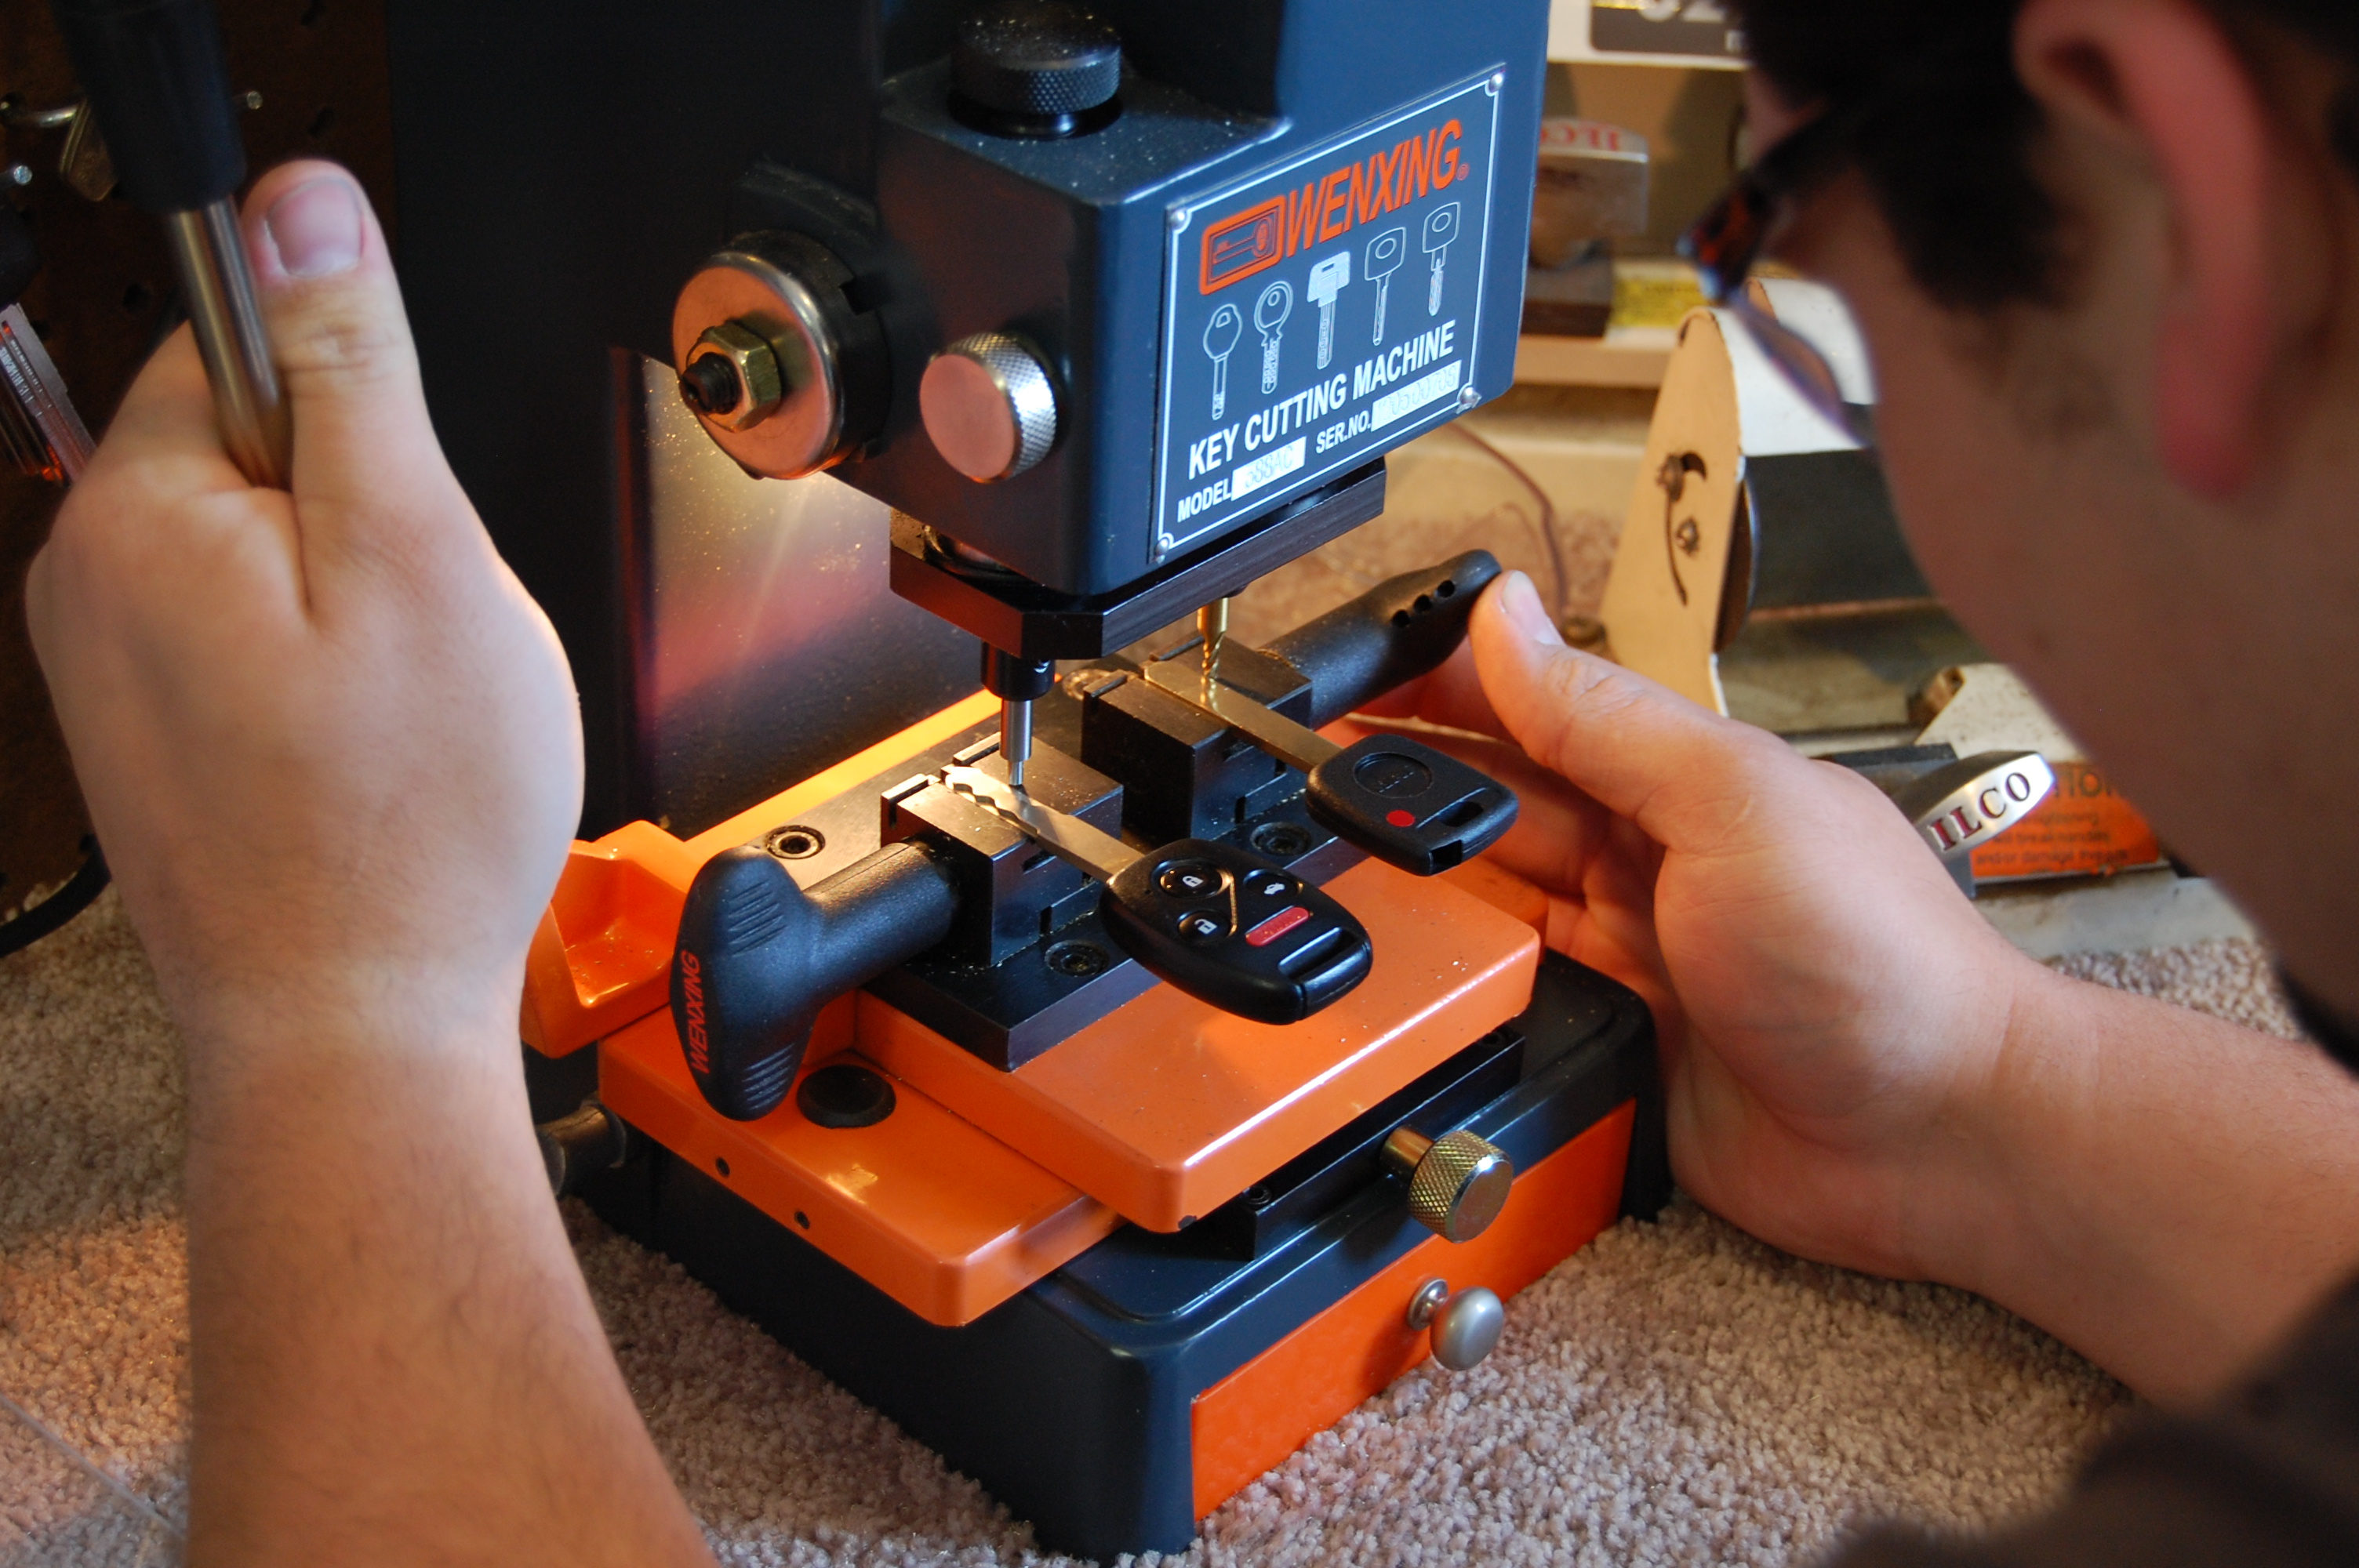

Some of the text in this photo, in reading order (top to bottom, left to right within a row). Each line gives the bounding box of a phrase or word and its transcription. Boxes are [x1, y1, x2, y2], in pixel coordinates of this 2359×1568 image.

[1285, 118, 1463, 257] WENXING
[1188, 320, 1456, 479] KEY CUTTING MACHINE
[1177, 477, 1232, 522] MODEL
[1926, 771, 2031, 852] ILCO
[681, 950, 710, 1073] WENXING
